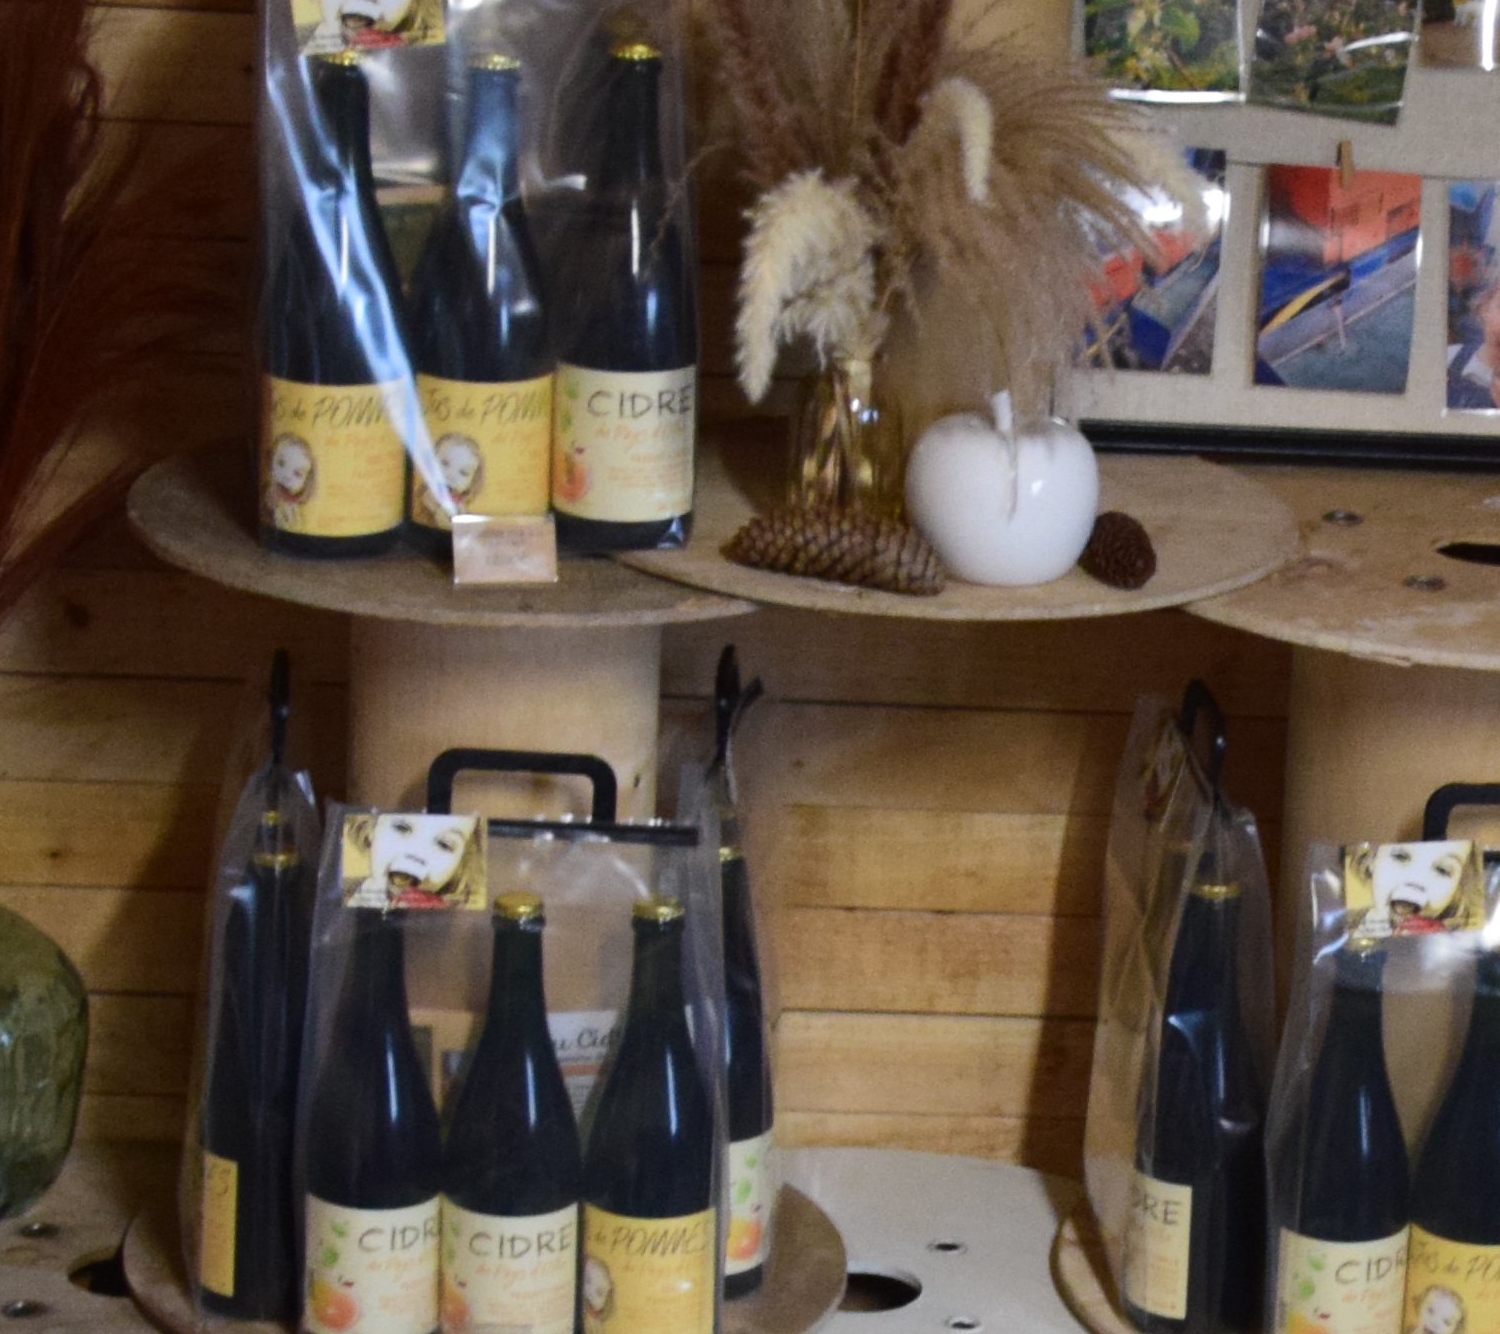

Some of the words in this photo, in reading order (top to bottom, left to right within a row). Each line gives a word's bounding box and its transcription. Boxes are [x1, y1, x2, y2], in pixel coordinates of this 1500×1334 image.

[587, 383, 693, 418] CIDRE
[358, 1217, 438, 1253] CIDR
[468, 1222, 574, 1259] CIDRE
[1334, 1245, 1408, 1285] CIDR
